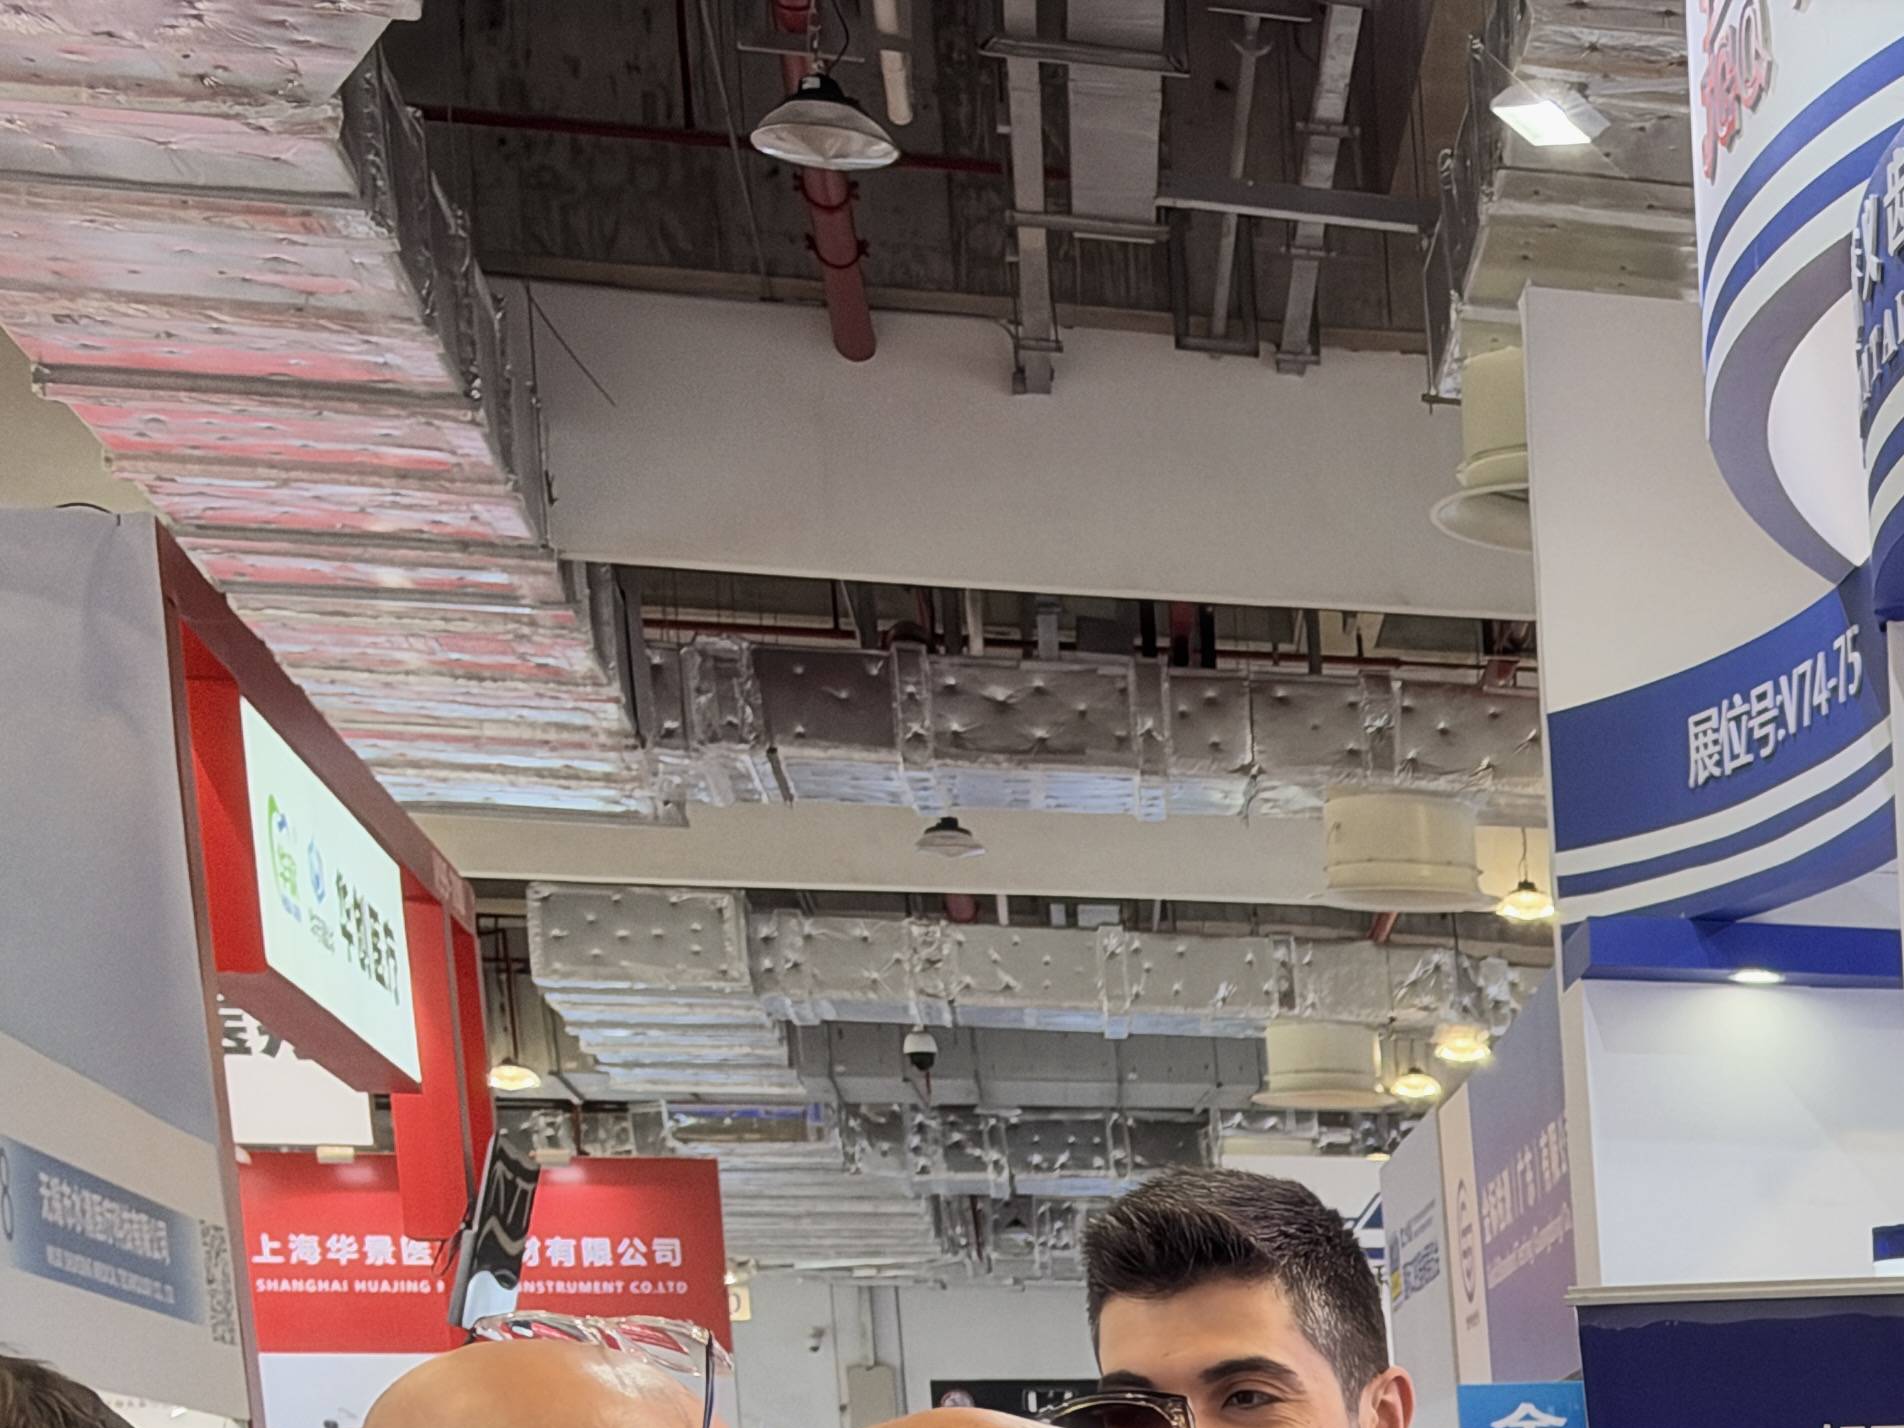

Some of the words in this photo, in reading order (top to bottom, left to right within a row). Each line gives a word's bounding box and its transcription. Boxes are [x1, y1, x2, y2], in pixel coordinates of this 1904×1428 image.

[251, 1232, 683, 1268] 上海华景医材有限公司
[255, 1278, 349, 1295] SHANGHAI
[354, 1279, 432, 1295] HUAJING
